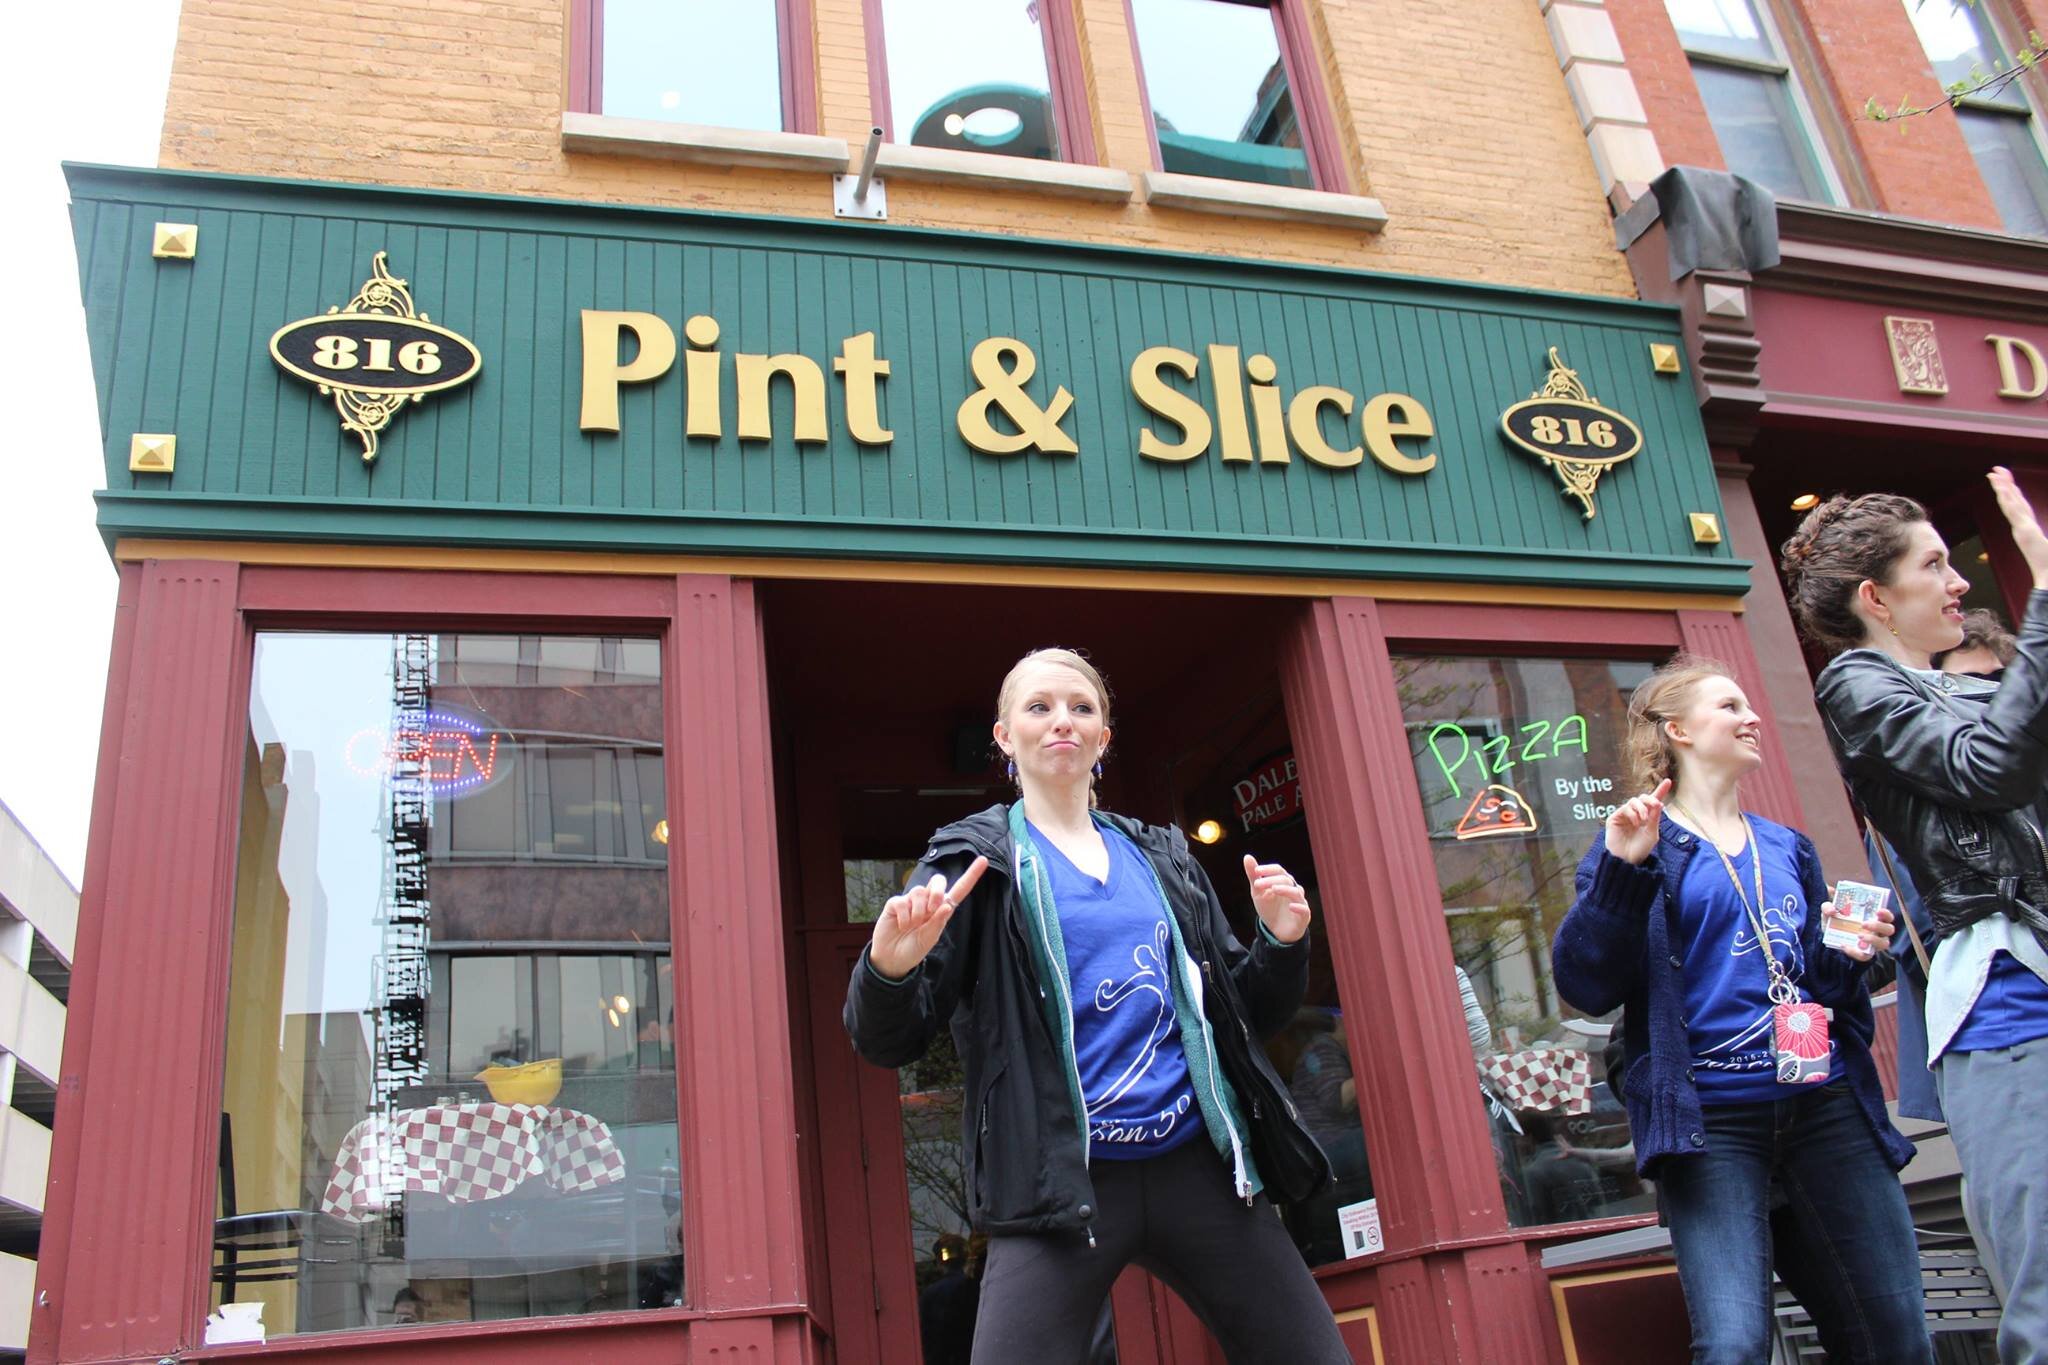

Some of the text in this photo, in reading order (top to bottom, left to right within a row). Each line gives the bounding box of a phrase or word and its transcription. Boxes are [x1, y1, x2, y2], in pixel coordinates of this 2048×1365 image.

[312, 335, 442, 375] 816
[579, 308, 1437, 475] Pint & Slice
[1530, 415, 1617, 448] 816
[345, 728, 498, 781] OPEN
[1554, 775, 1613, 799] By the
[1241, 794, 1287, 833] PALE
[1572, 803, 1617, 820] Slice
